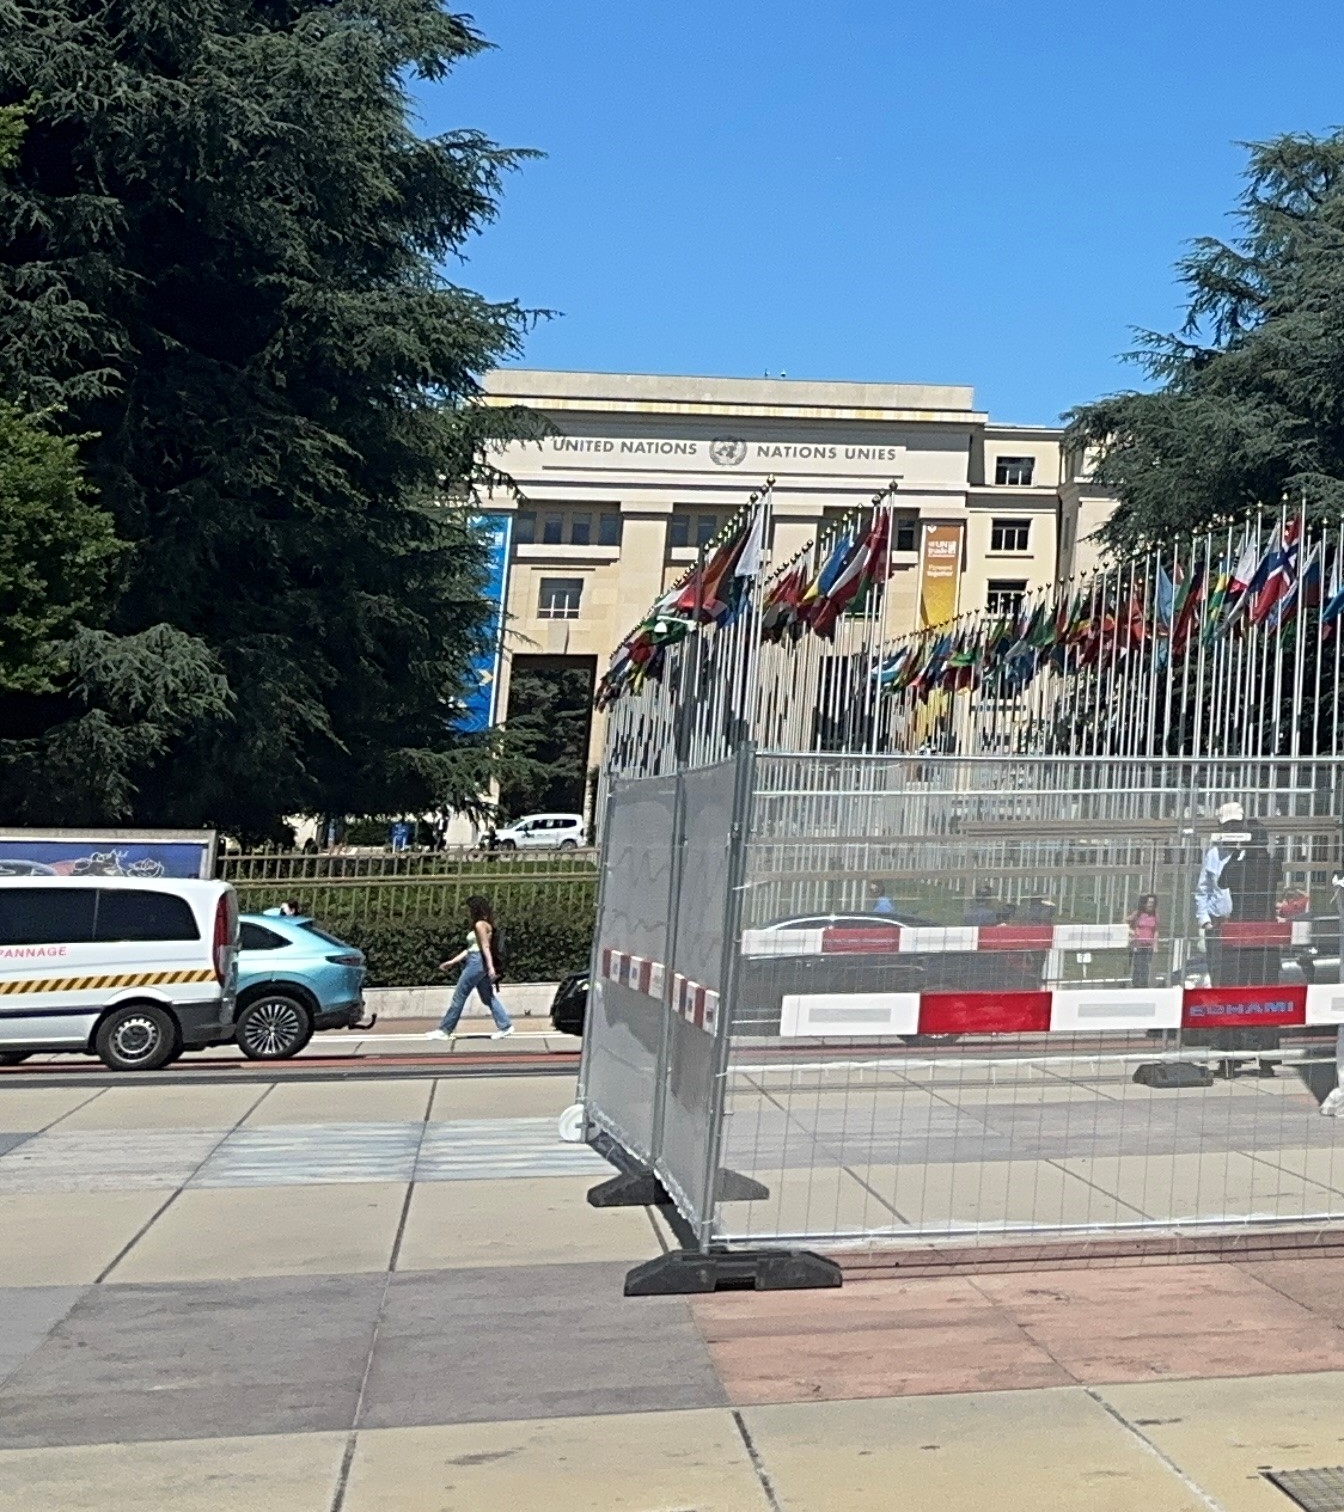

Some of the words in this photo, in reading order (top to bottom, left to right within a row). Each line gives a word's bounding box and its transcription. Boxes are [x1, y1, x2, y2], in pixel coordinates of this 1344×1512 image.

[553, 440, 614, 453] UNITED
[621, 441, 697, 455] NATIONS
[757, 445, 836, 459] NATIONS
[845, 447, 895, 460] UNIES
